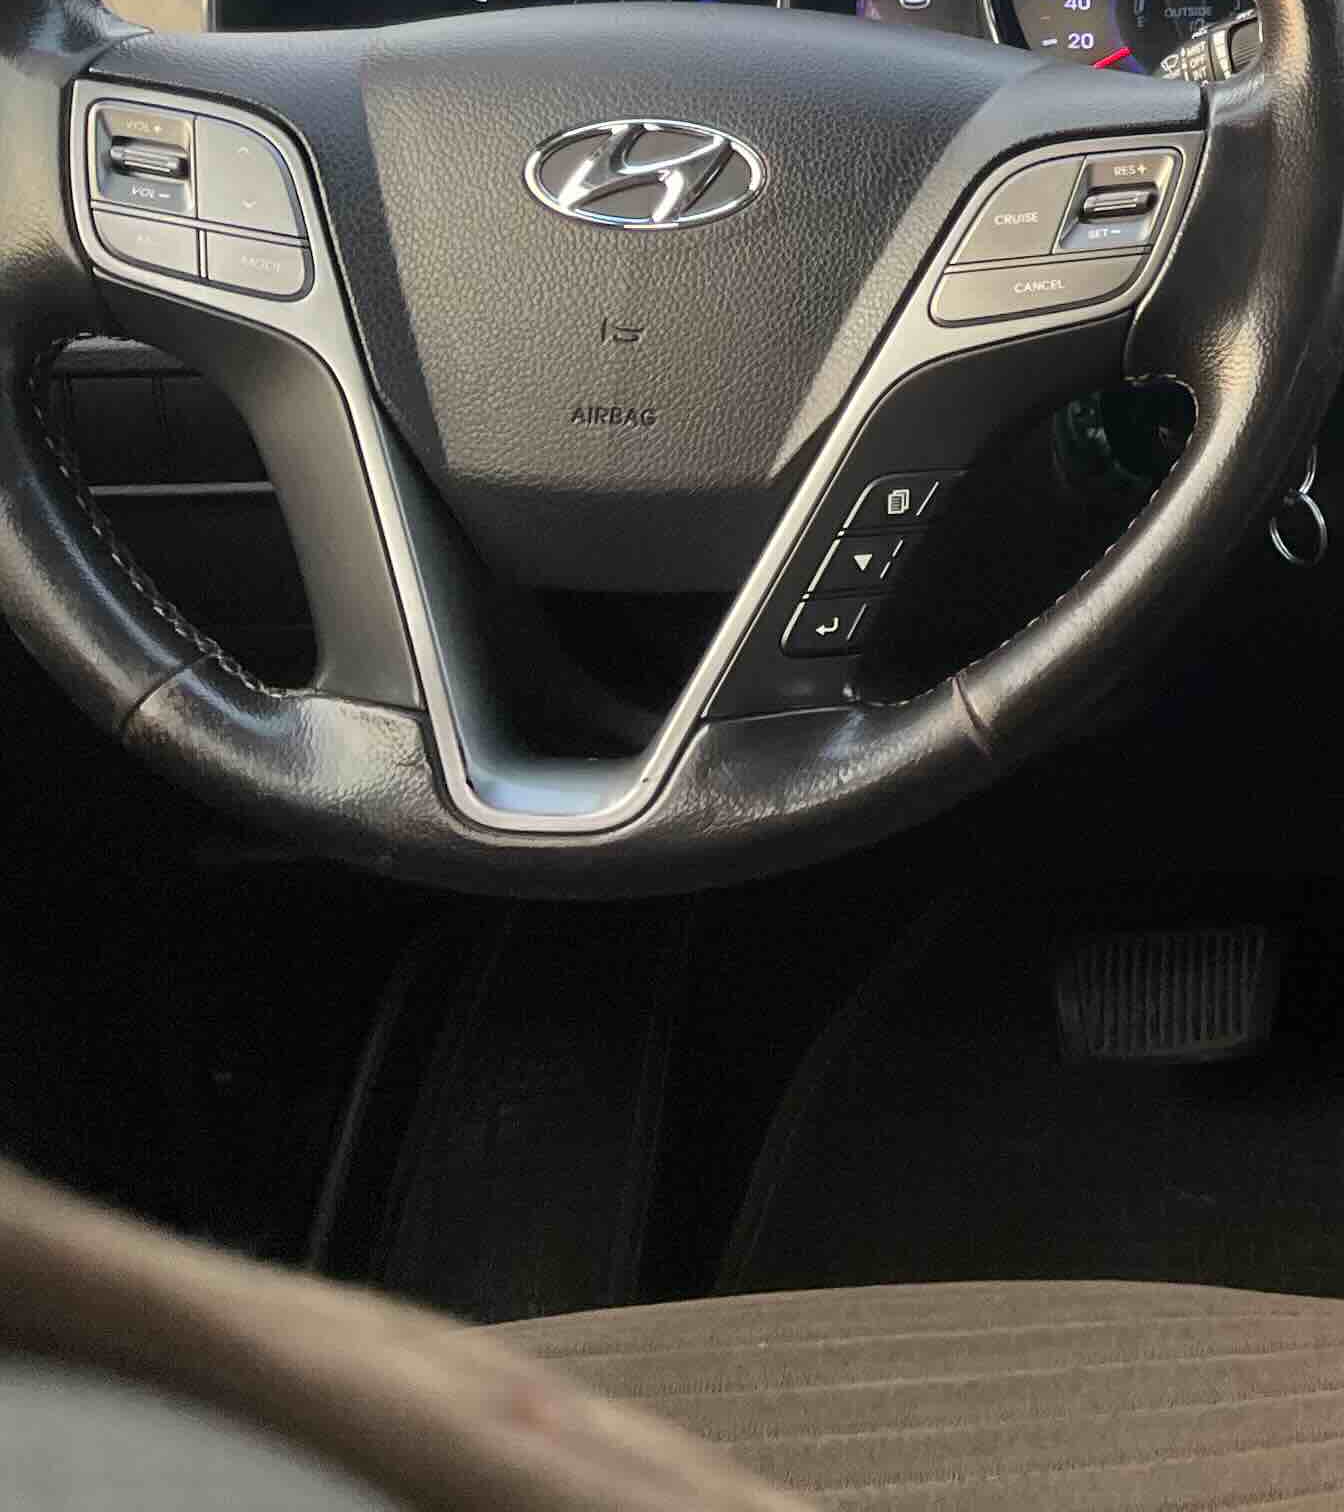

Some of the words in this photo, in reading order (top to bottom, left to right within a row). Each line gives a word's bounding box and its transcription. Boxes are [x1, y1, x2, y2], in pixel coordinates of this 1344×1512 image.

[1067, 33, 1094, 50] 20
[994, 211, 1039, 226] CRUISE
[1013, 279, 1065, 294] CANCEL
[570, 406, 658, 427] AIRBAG
